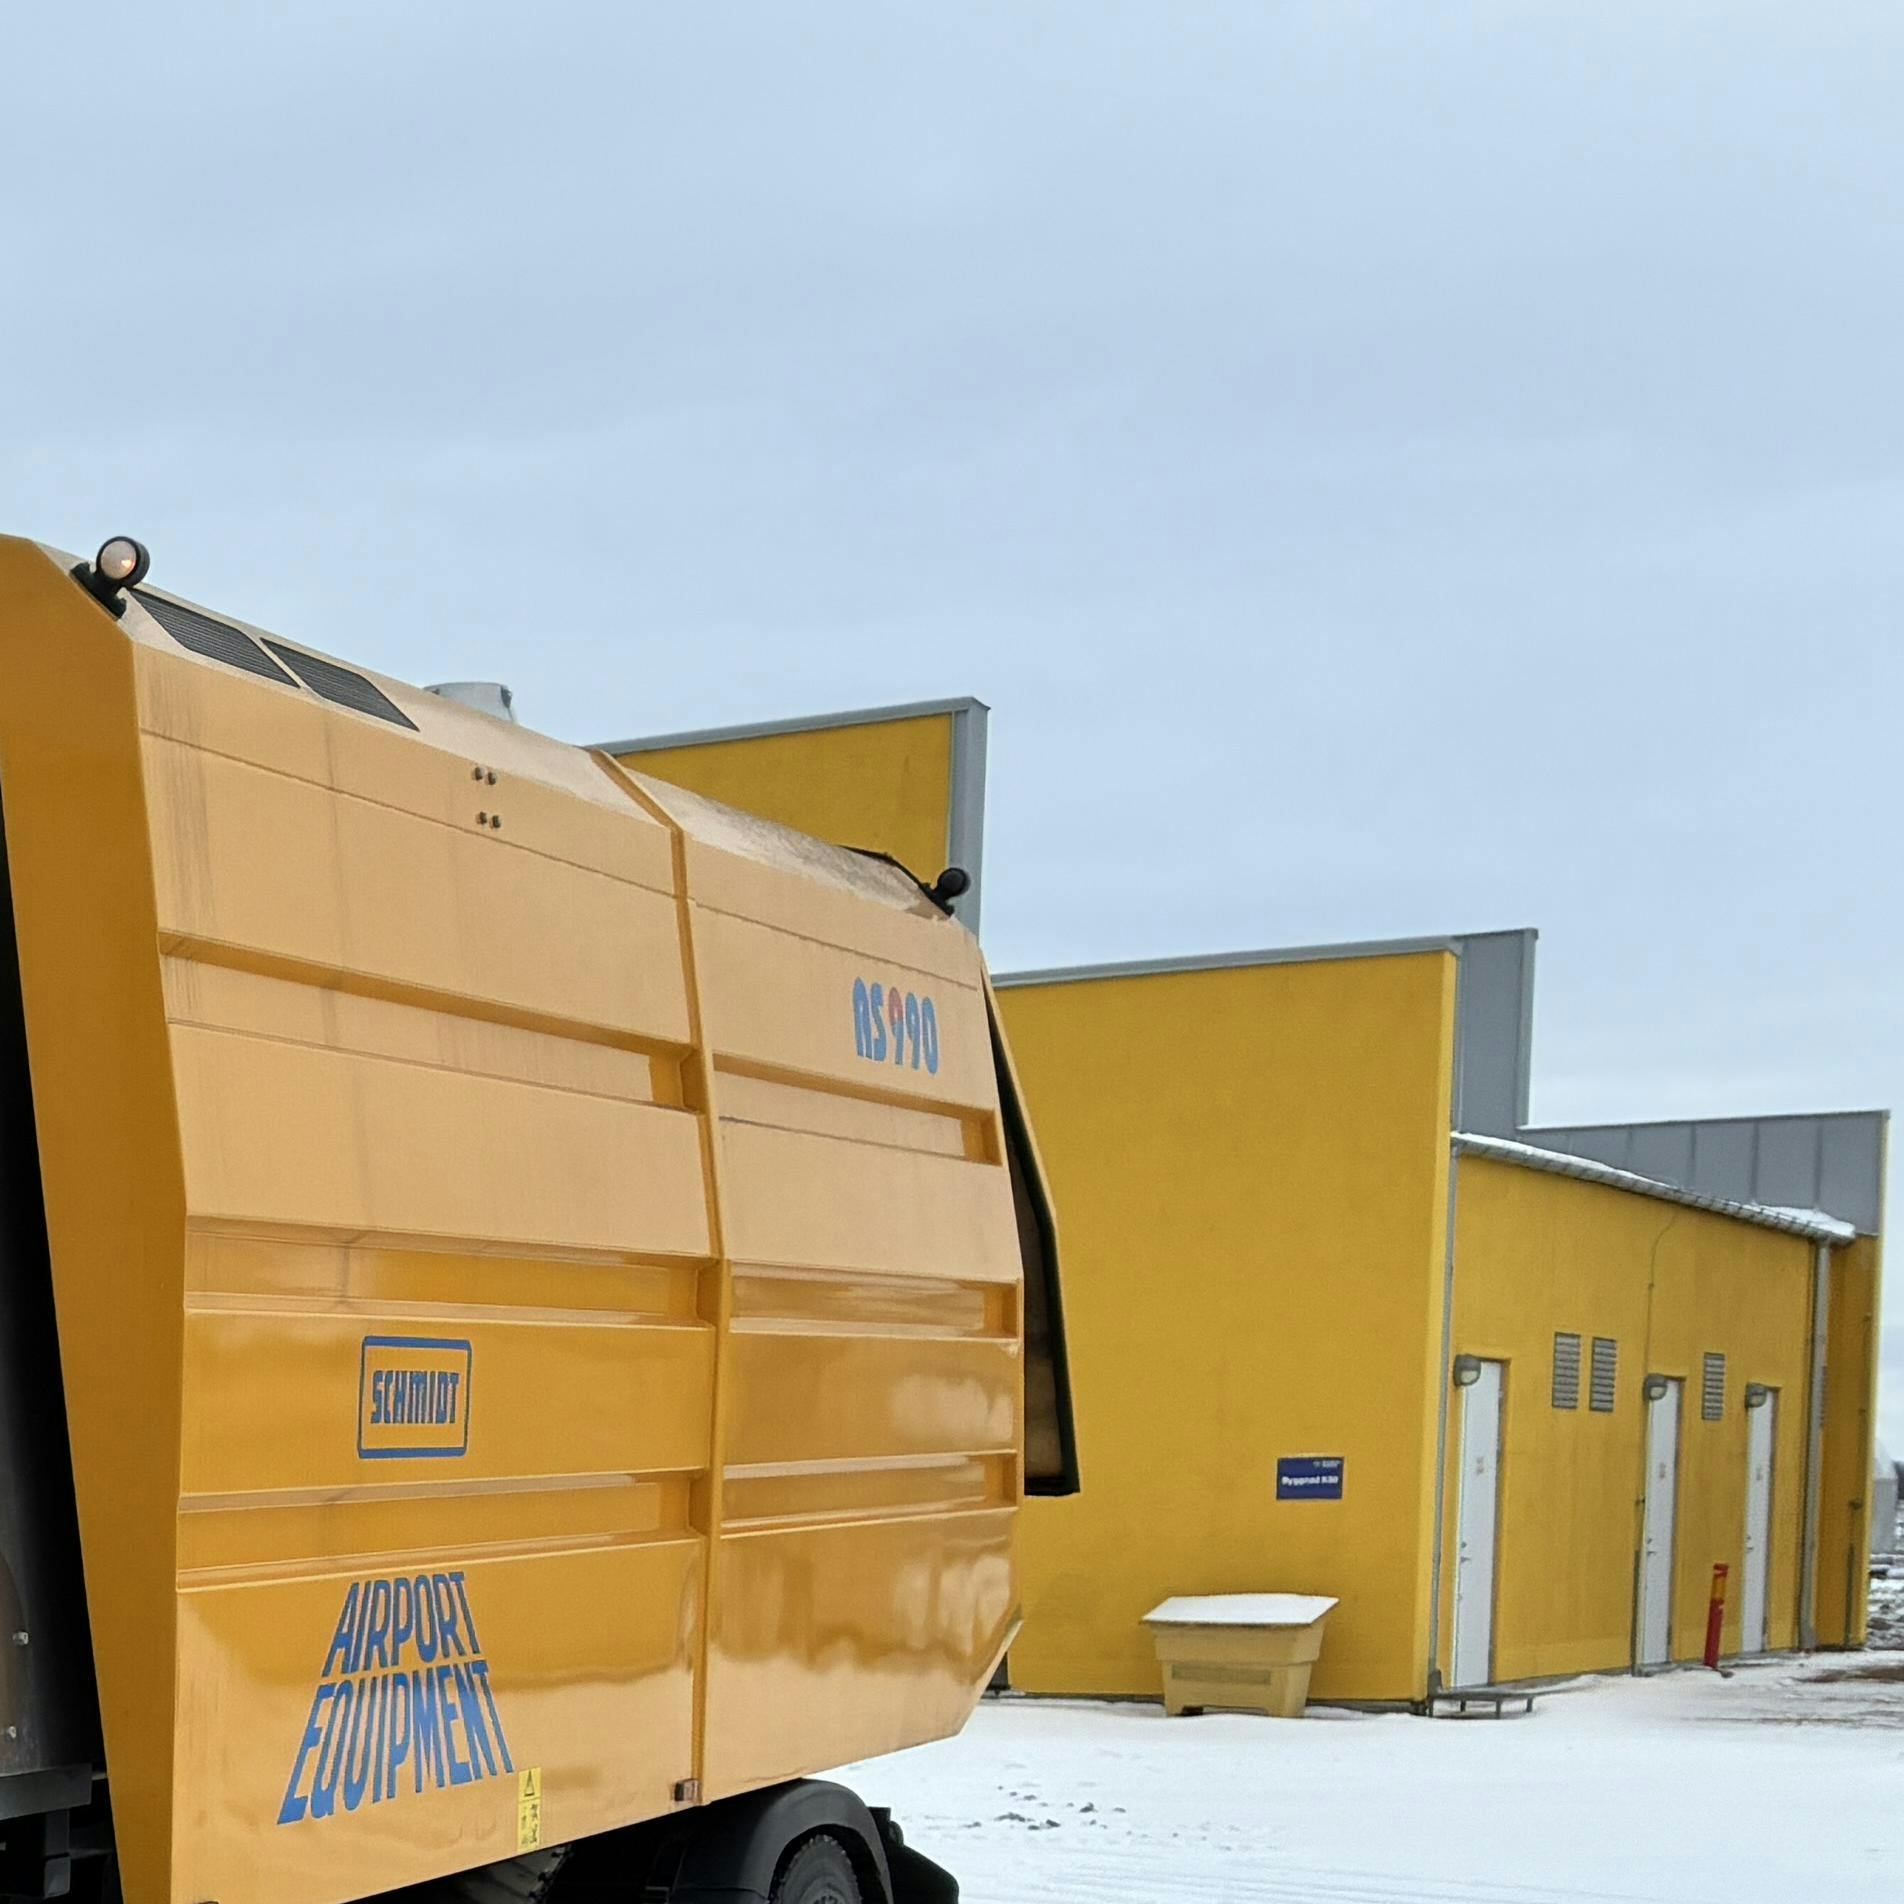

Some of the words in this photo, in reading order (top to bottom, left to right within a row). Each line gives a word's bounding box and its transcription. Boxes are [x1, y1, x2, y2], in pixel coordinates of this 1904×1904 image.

[371, 1370, 459, 1424] SCHMIDT
[321, 1571, 481, 1678] AIRPORT
[277, 1660, 514, 1825] EQUIPMENT
